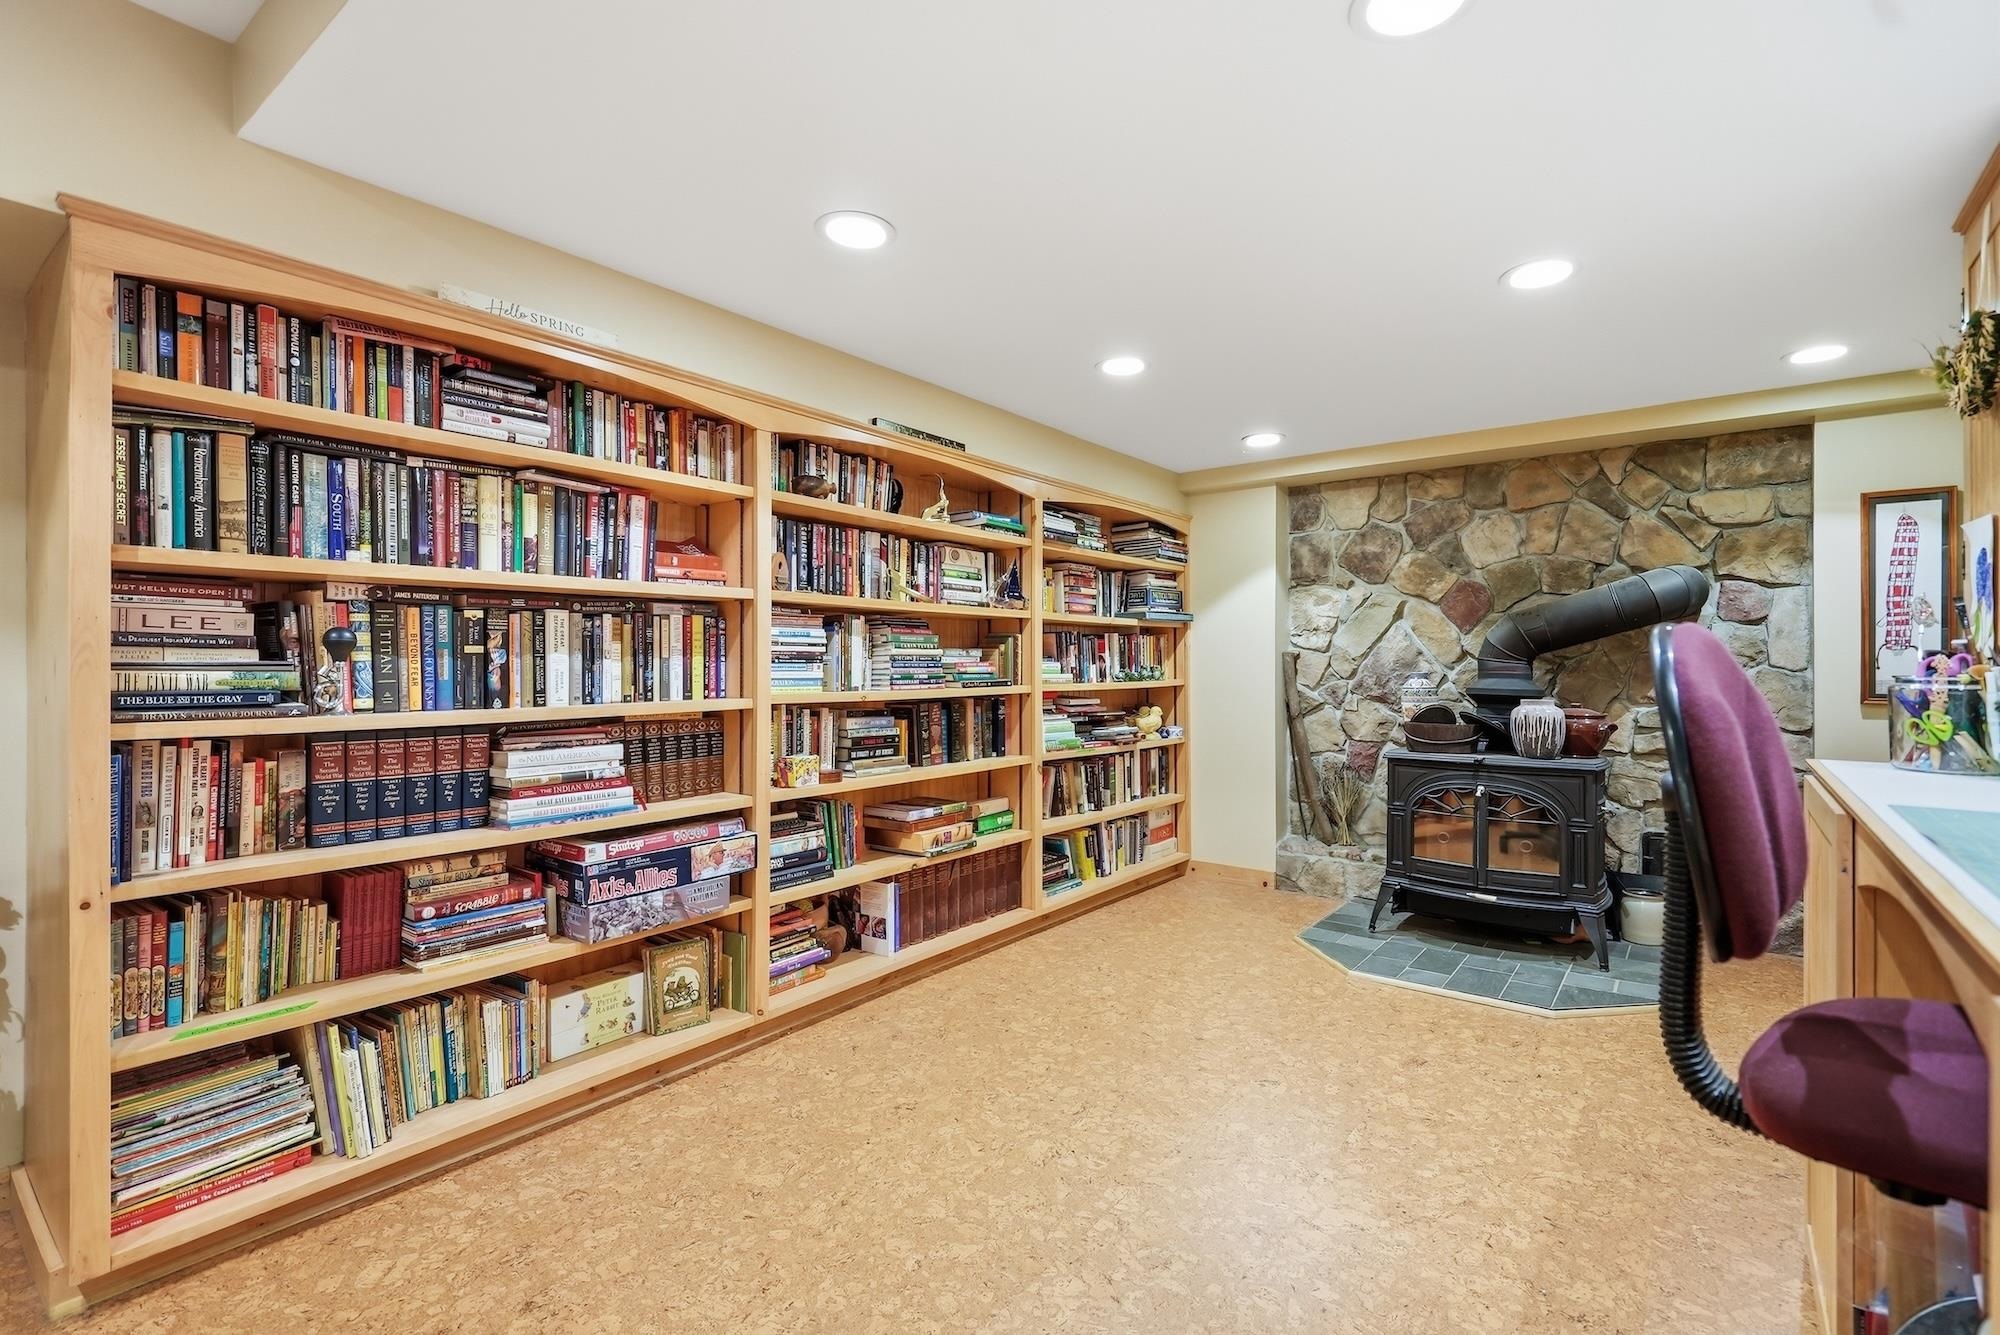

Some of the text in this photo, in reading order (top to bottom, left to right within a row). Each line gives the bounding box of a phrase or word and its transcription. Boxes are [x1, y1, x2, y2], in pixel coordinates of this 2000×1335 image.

[486, 298, 585, 338] Hello SPRING
[160, 335, 172, 355] Salt
[290, 318, 300, 356] BEOWULF
[451, 379, 464, 387] THE
[585, 391, 593, 407] ISIS
[116, 435, 127, 526] JESSE JAMES' SECRET
[255, 467, 267, 499] GHOST
[280, 484, 285, 493] OF
[190, 448, 208, 537] Remembering America
[331, 493, 343, 530] SOUTH
[256, 516, 266, 548] WIRES
[197, 588, 225, 596] OPEN
[413, 593, 439, 601] PATTERSON
[142, 614, 221, 630] LEE
[128, 635, 161, 643] DEADLIEST
[218, 637, 234, 645] WEST
[380, 630, 392, 674] TITAN
[423, 612, 435, 701] DECLINING FORTUNES
[116, 673, 209, 691] THE CIVIL WAR
[118, 695, 244, 705] THE BLUE AND THE GRAY
[142, 711, 187, 721] BRADY'S
[192, 710, 216, 719] CIVIL
[239, 709, 278, 718] JOURNAL
[200, 755, 208, 764] THE
[526, 751, 600, 763] NATIVE AMERICANS
[110, 762, 118, 785] TRAIL
[141, 745, 153, 798] LET ME BE FREE
[199, 766, 207, 781] HEART
[553, 784, 581, 793] INDIAN
[584, 781, 604, 790] WARS
[555, 797, 576, 805] BATTLES
[209, 786, 218, 840] CROW KILLER
[110, 818, 118, 839] WEST
[609, 840, 645, 855] Stratego
[588, 867, 678, 904] Axis & Allies
[693, 883, 724, 893] AMERICAN
[454, 894, 500, 914] SCRABBLE
[685, 953, 699, 961] Toad
[596, 1003, 620, 1015] RABBIT
[597, 997, 617, 1007] PETER
[176, 1161, 275, 1200] TINTIN The Complete Companion
[174, 1171, 274, 1211] TINTIN The Complete Companion
